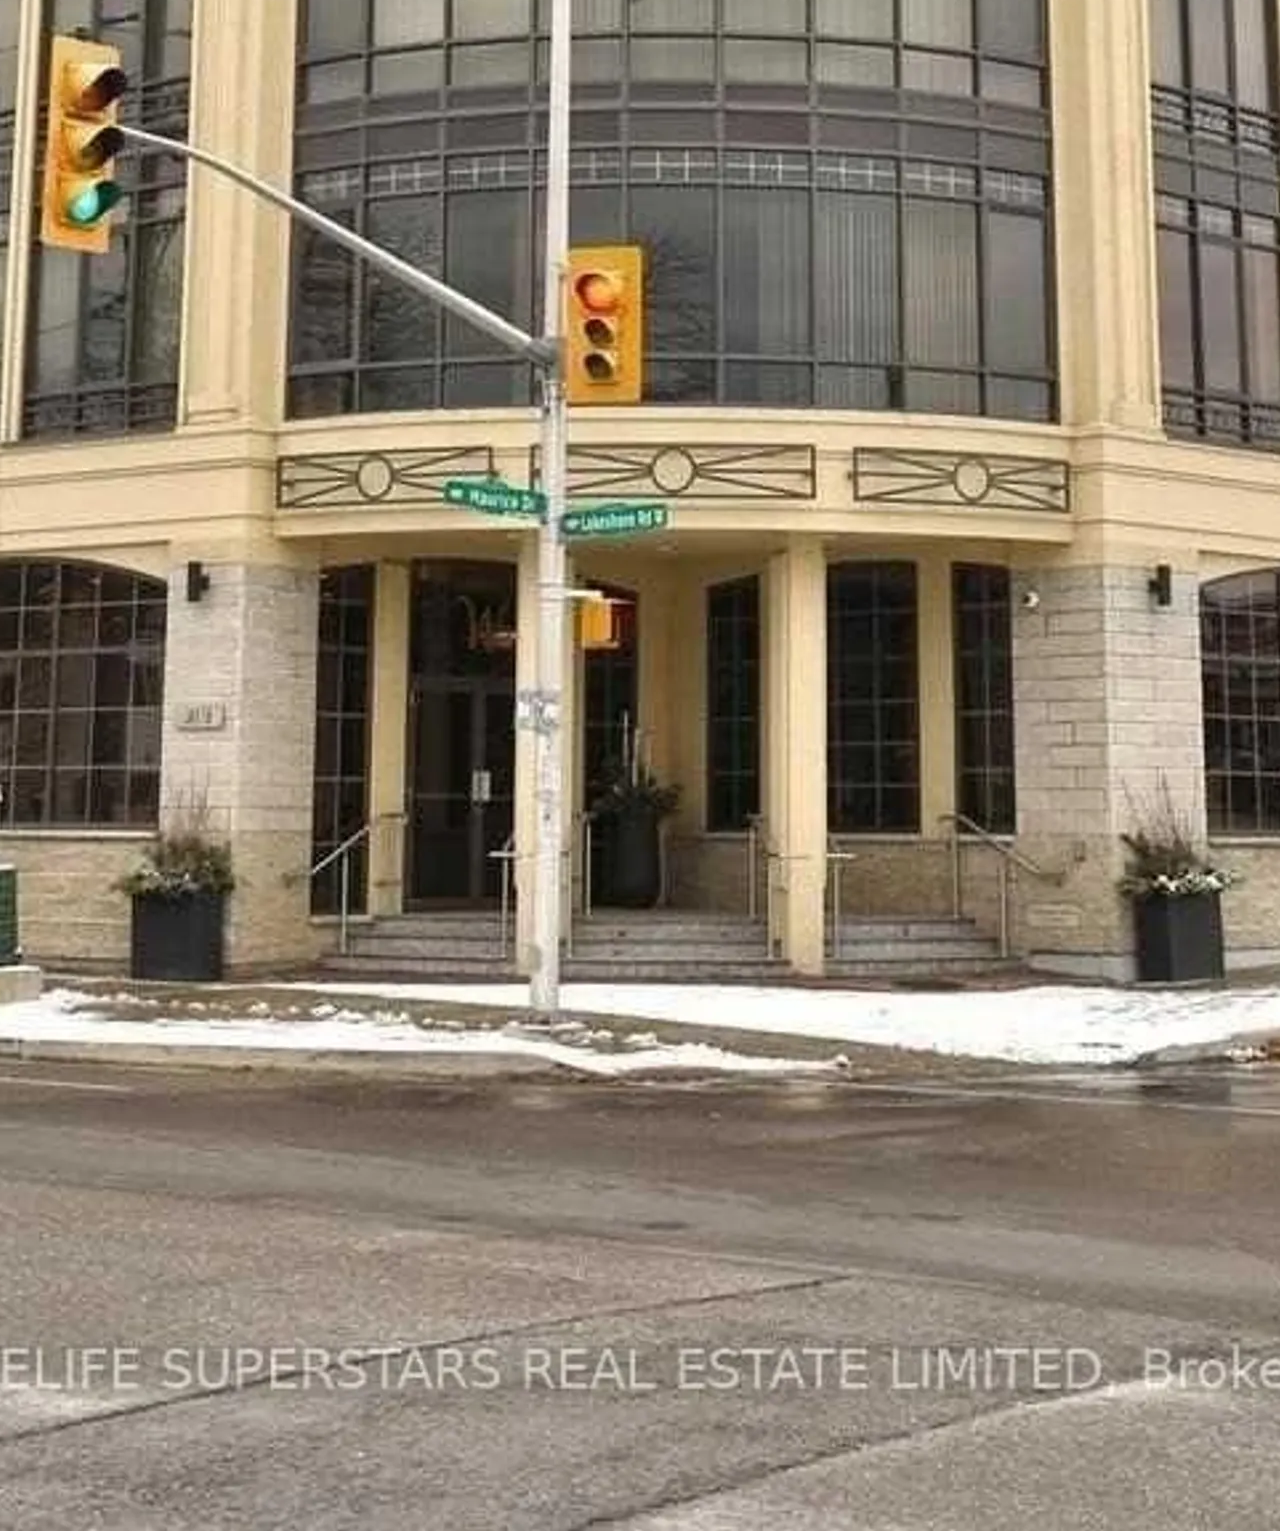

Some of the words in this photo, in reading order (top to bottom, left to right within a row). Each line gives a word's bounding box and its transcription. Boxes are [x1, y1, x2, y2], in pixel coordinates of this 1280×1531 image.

[469, 489, 518, 509] Maurice
[581, 512, 635, 531] Lakeshore
[637, 509, 652, 526] Rd
